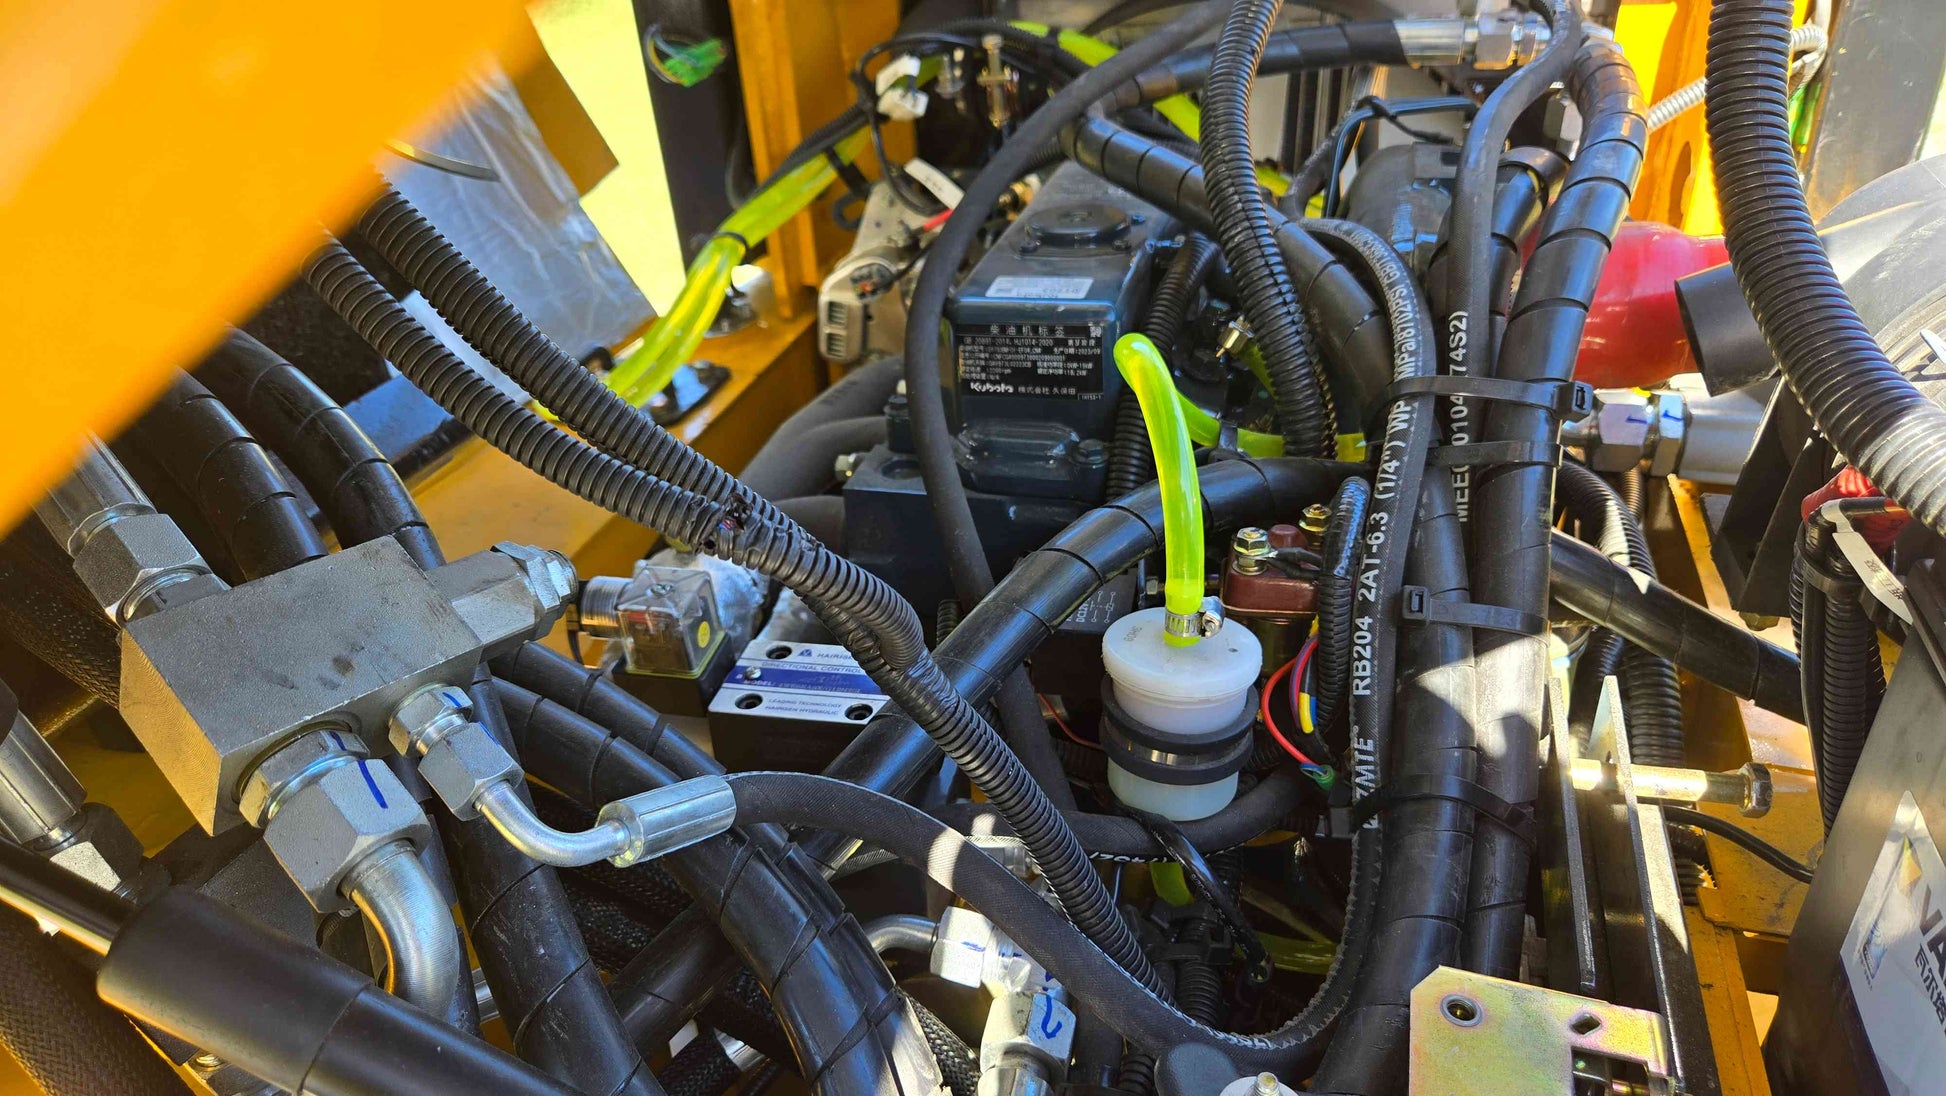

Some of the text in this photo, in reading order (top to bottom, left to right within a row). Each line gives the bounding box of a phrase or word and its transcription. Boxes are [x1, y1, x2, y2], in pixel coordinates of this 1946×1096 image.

[969, 381, 1014, 393] Kubota
[1386, 400, 1412, 434] WP
[1373, 439, 1406, 499] (1/4")
[1357, 510, 1389, 602] 2AT-6.3
[761, 661, 862, 674] DIRECTIONAL CONTROL
[1353, 615, 1375, 696] RB204
[1919, 884, 1946, 989] VA
